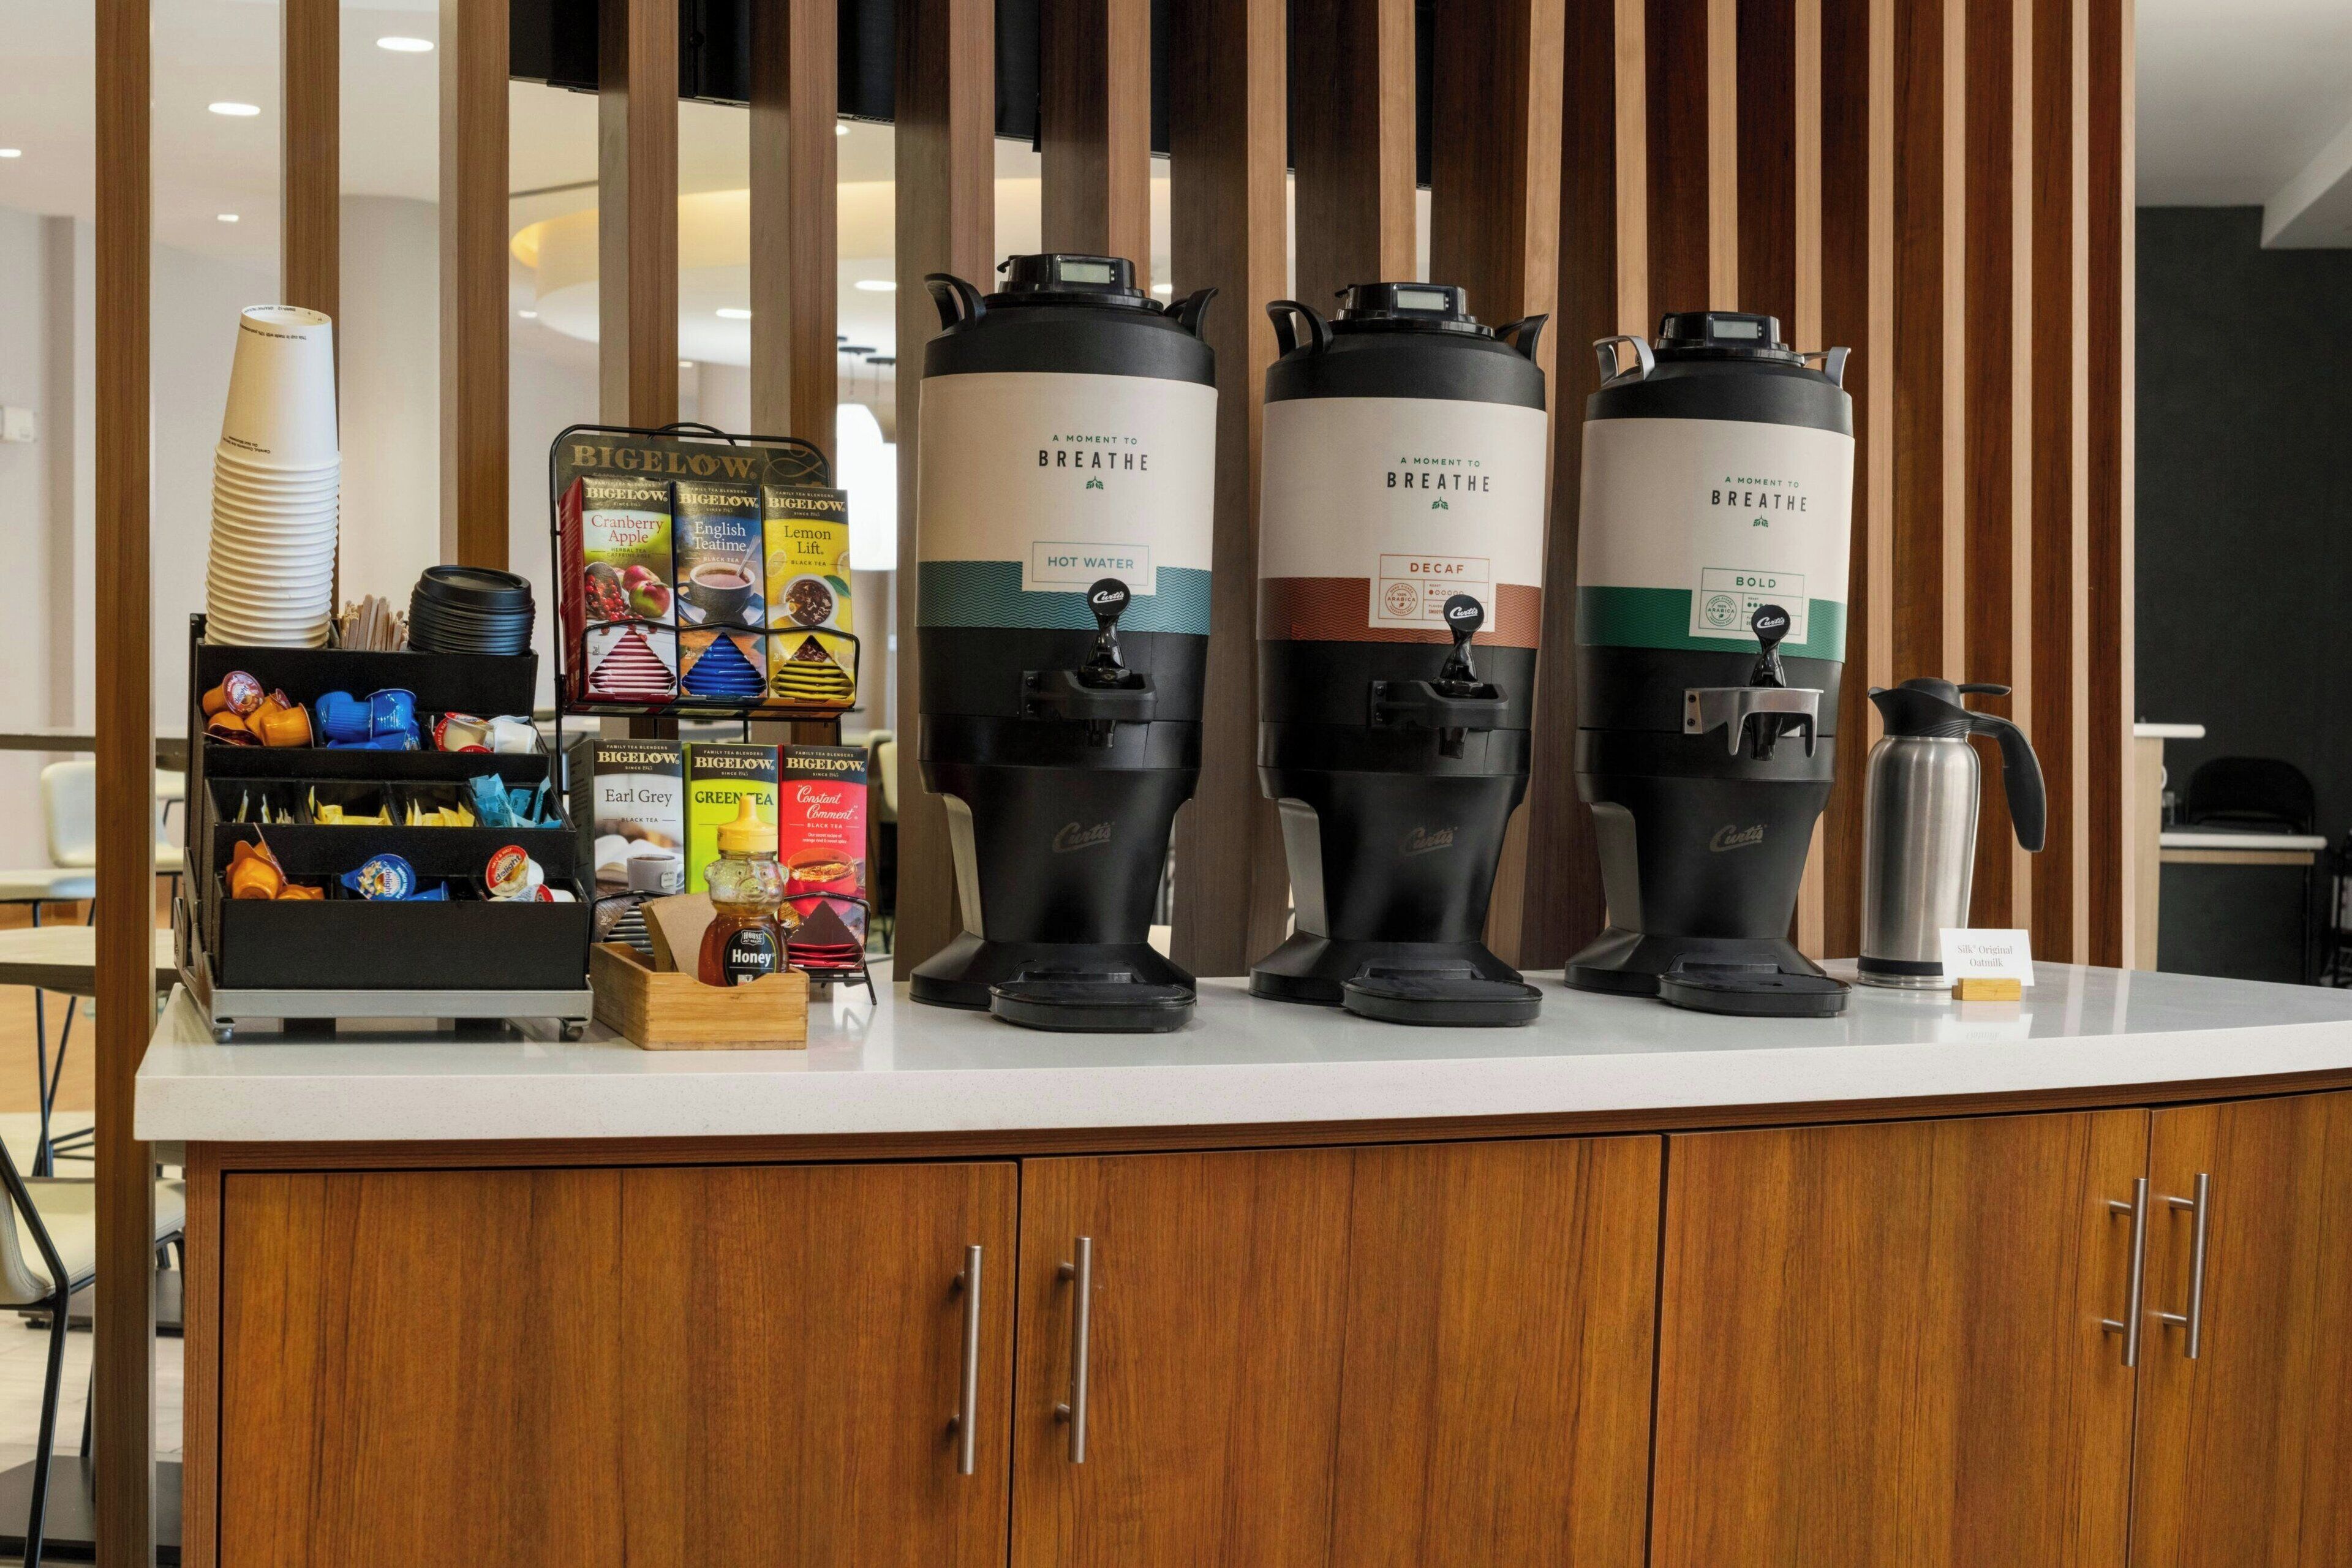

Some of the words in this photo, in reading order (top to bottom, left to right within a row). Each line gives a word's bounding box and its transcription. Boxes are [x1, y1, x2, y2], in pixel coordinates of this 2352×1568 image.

[1066, 435, 1117, 444] MOMENT
[1038, 450, 1148, 471] BREATHE
[1414, 458, 1461, 466] MOMENT
[1387, 472, 1490, 492] BREATHE
[1738, 477, 1782, 486] MOMENT
[1711, 490, 1807, 512] BREATHE
[591, 514, 664, 533] Cranberry
[695, 521, 745, 538] English
[609, 529, 649, 547] Apple
[784, 526, 831, 540] Lemon
[1047, 556, 1078, 567] HOT
[1084, 558, 1134, 569] WATER
[1410, 562, 1464, 574] DECAF
[1736, 576, 1776, 588] BOLD
[1093, 590, 1125, 604] Curtis
[1449, 606, 1478, 619] Curtis
[1757, 617, 1785, 628] Curtis
[235, 685, 249, 704] delight
[605, 789, 635, 802] Earl
[638, 790, 673, 807] Grey
[1052, 821, 1114, 854] Curtis
[1400, 826, 1455, 857] Curtis
[1709, 824, 1764, 853] Curtis
[495, 855, 521, 881] delight
[383, 868, 393, 895] delight
[743, 931, 763, 940] HOUSE
[732, 949, 772, 968] Honey
[1978, 945, 2013, 956] Original
[1969, 958, 2004, 968] Oatmilk
